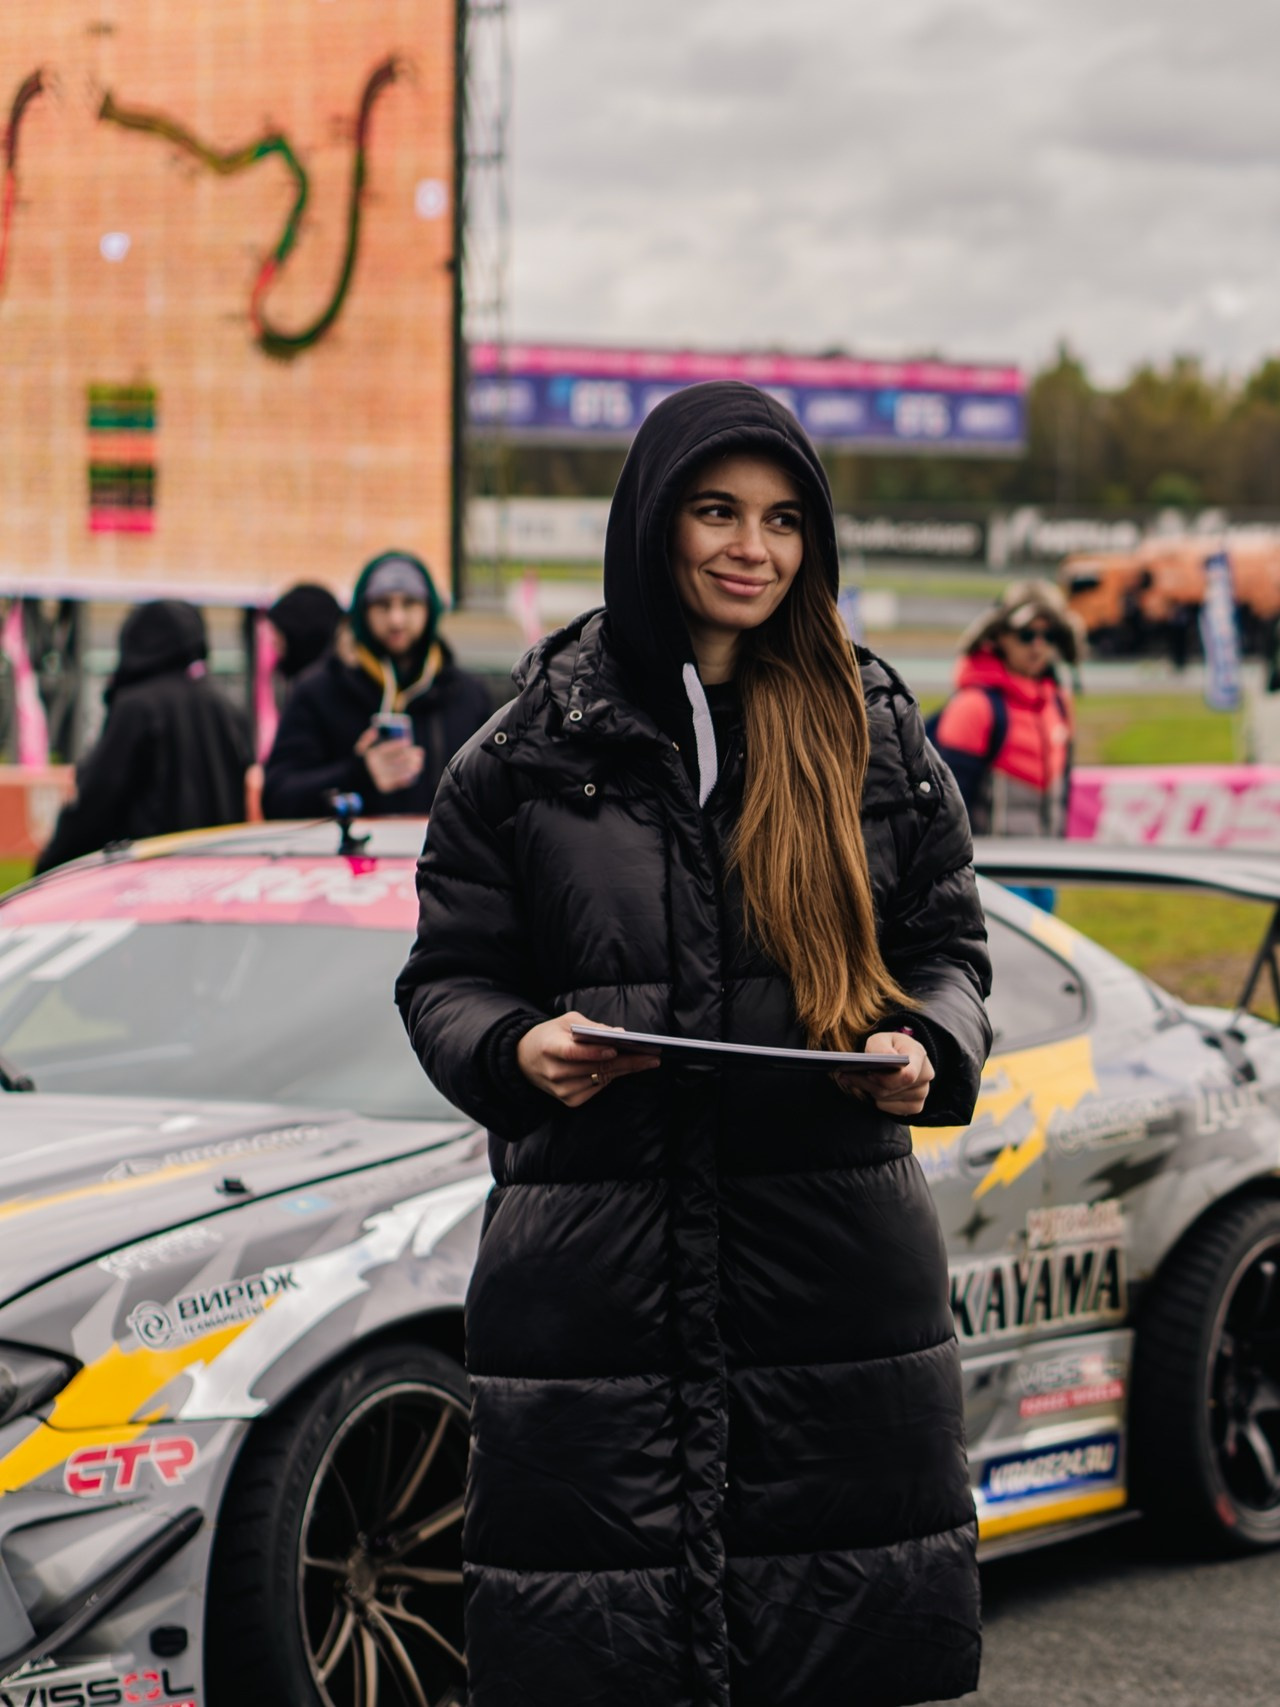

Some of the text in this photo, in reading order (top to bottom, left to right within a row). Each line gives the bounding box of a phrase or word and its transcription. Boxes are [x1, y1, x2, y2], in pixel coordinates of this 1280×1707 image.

[177, 1271, 301, 1320] ВИРАЖ
[949, 1244, 1126, 1342] KAYAMA
[64, 1434, 198, 1498] CTR
